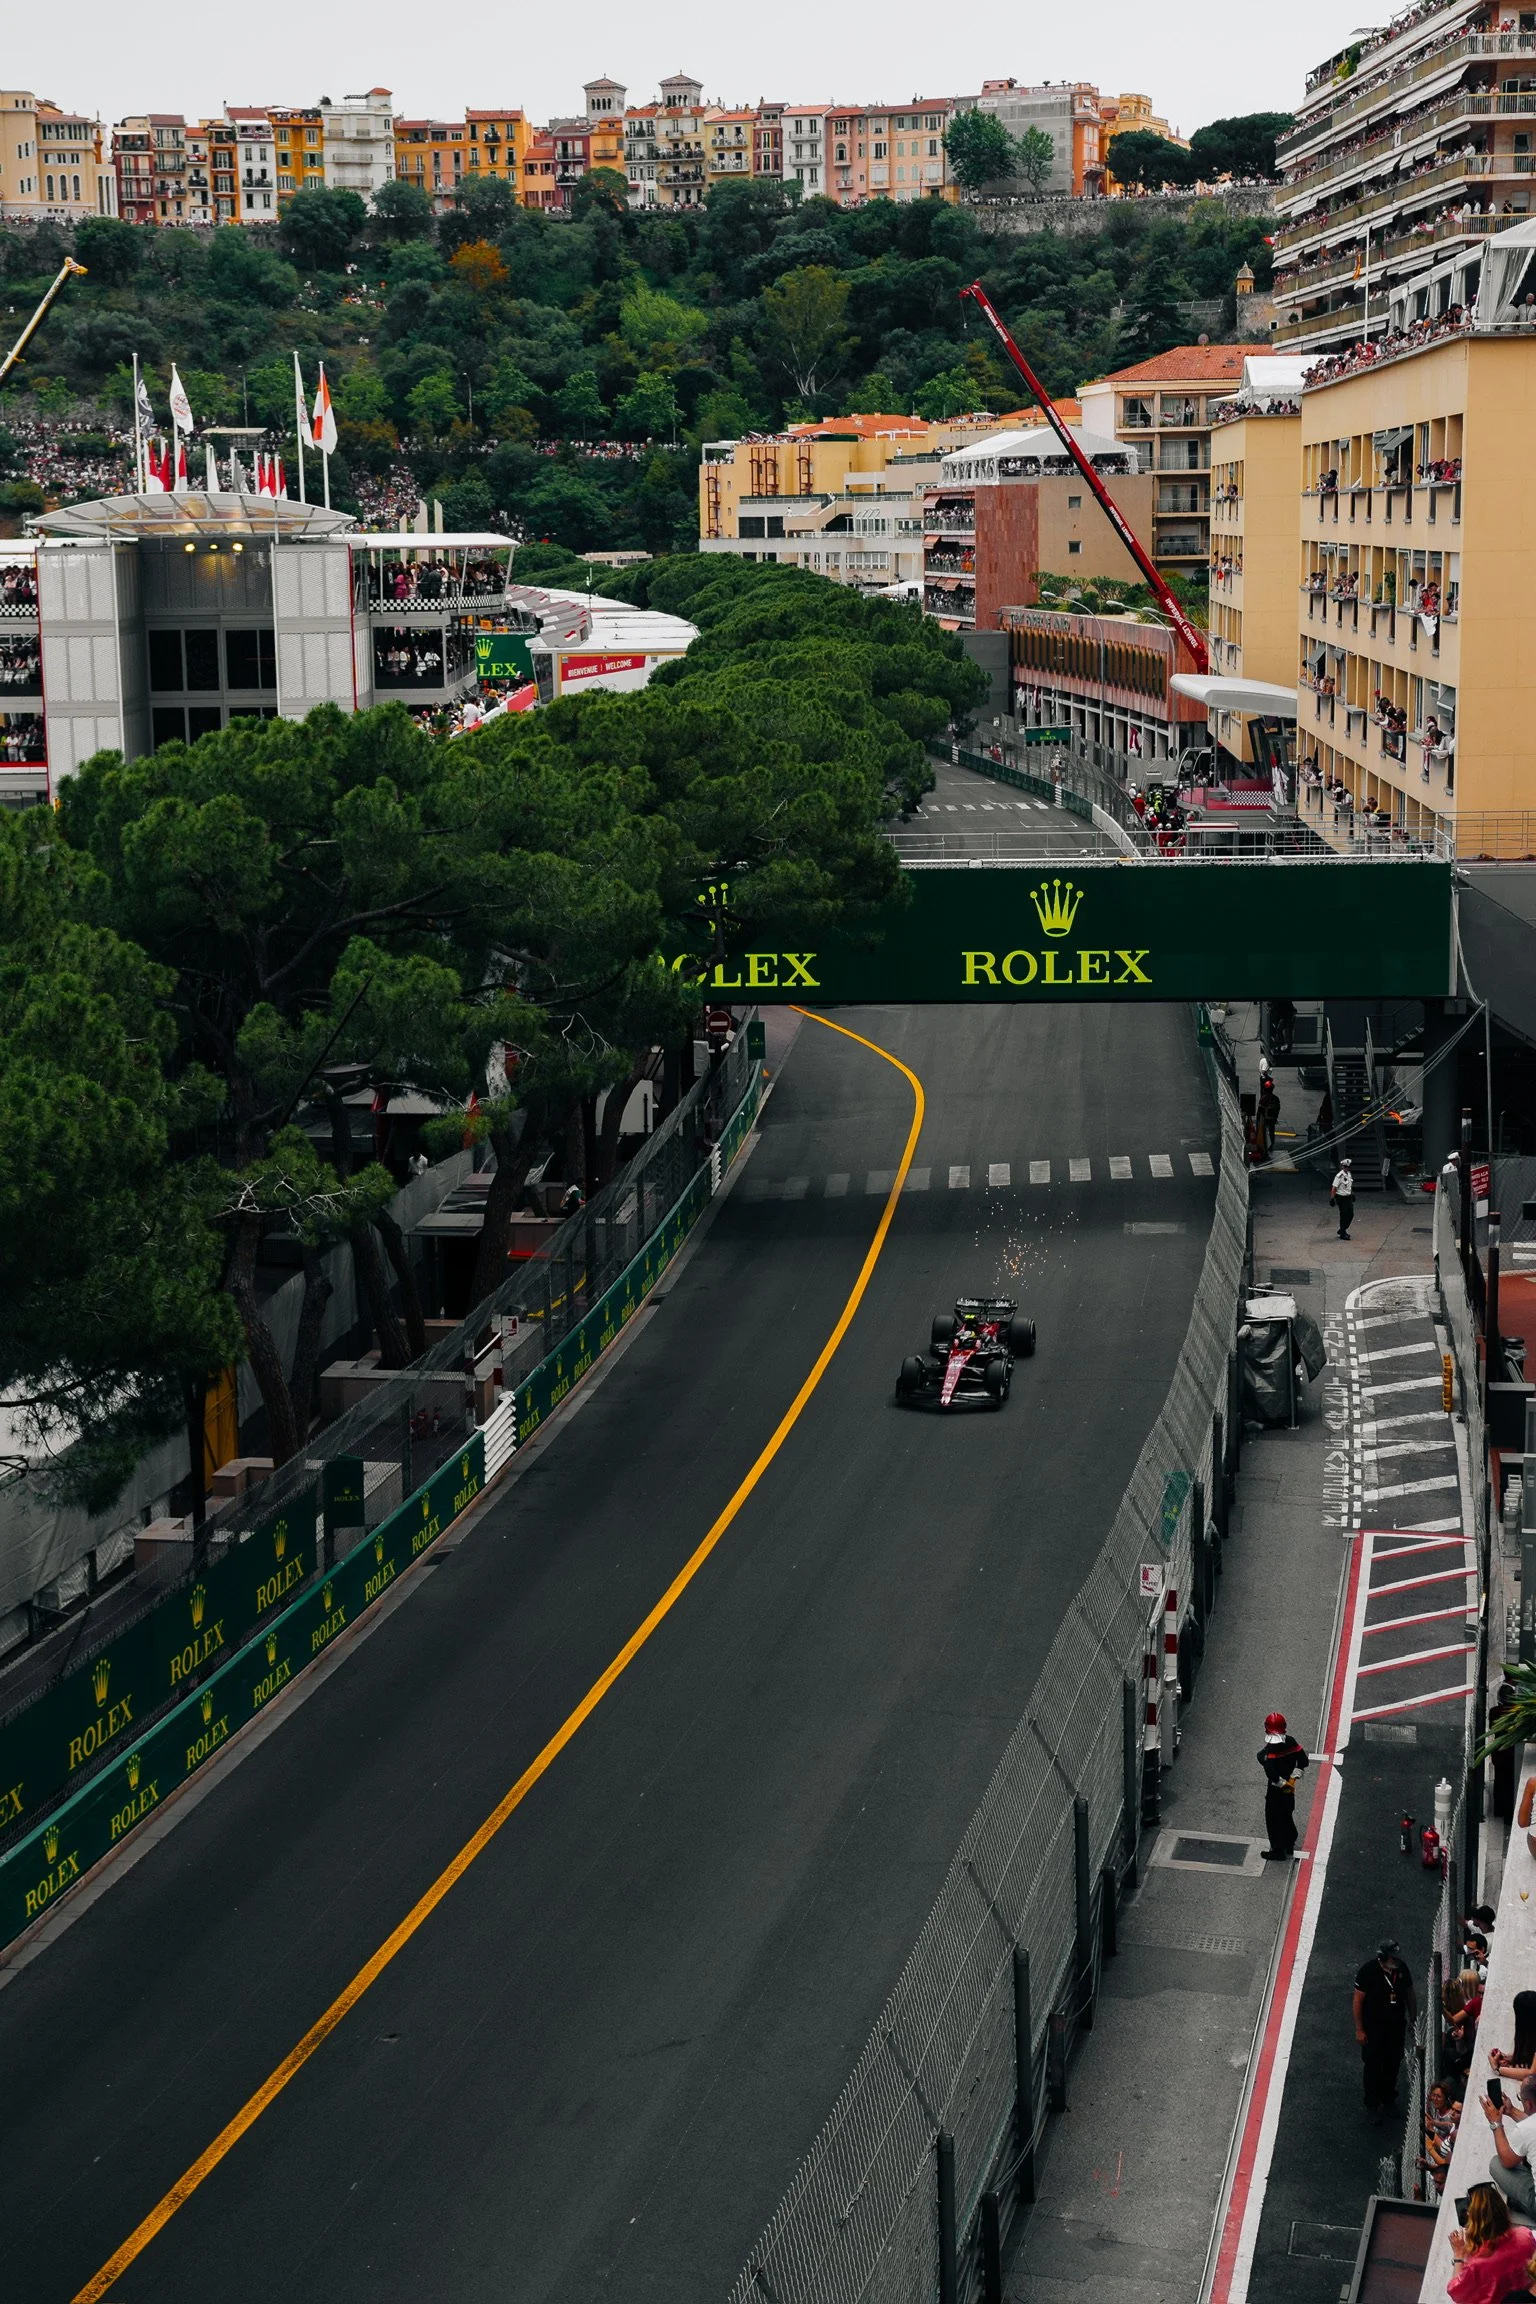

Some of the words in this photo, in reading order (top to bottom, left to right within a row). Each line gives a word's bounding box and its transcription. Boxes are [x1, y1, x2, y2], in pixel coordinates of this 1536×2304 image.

[1164, 597, 1184, 627] IMPERIAL
[1182, 624, 1198, 649] LEVAGE
[477, 663, 517, 676] LEX
[567, 665, 598, 678] BIENVENUE
[605, 659, 632, 671] WELCOME
[961, 949, 1153, 985] ROLEX
[519, 1406, 540, 1440] ROLEX
[454, 1475, 478, 1513] ROLEX
[411, 1515, 440, 1554] ROLEX
[256, 1553, 304, 1614] ROLEX
[364, 1558, 396, 1601] ROLEX
[170, 1619, 225, 1686] ROLEX
[312, 1605, 346, 1652] ROLEX
[253, 1658, 291, 1708] ROLEX
[69, 1694, 133, 1771] ROLEX
[186, 1715, 229, 1770] ROLEX
[110, 1780, 158, 1840] ROLEX
[25, 1851, 80, 1918] ROLEX
